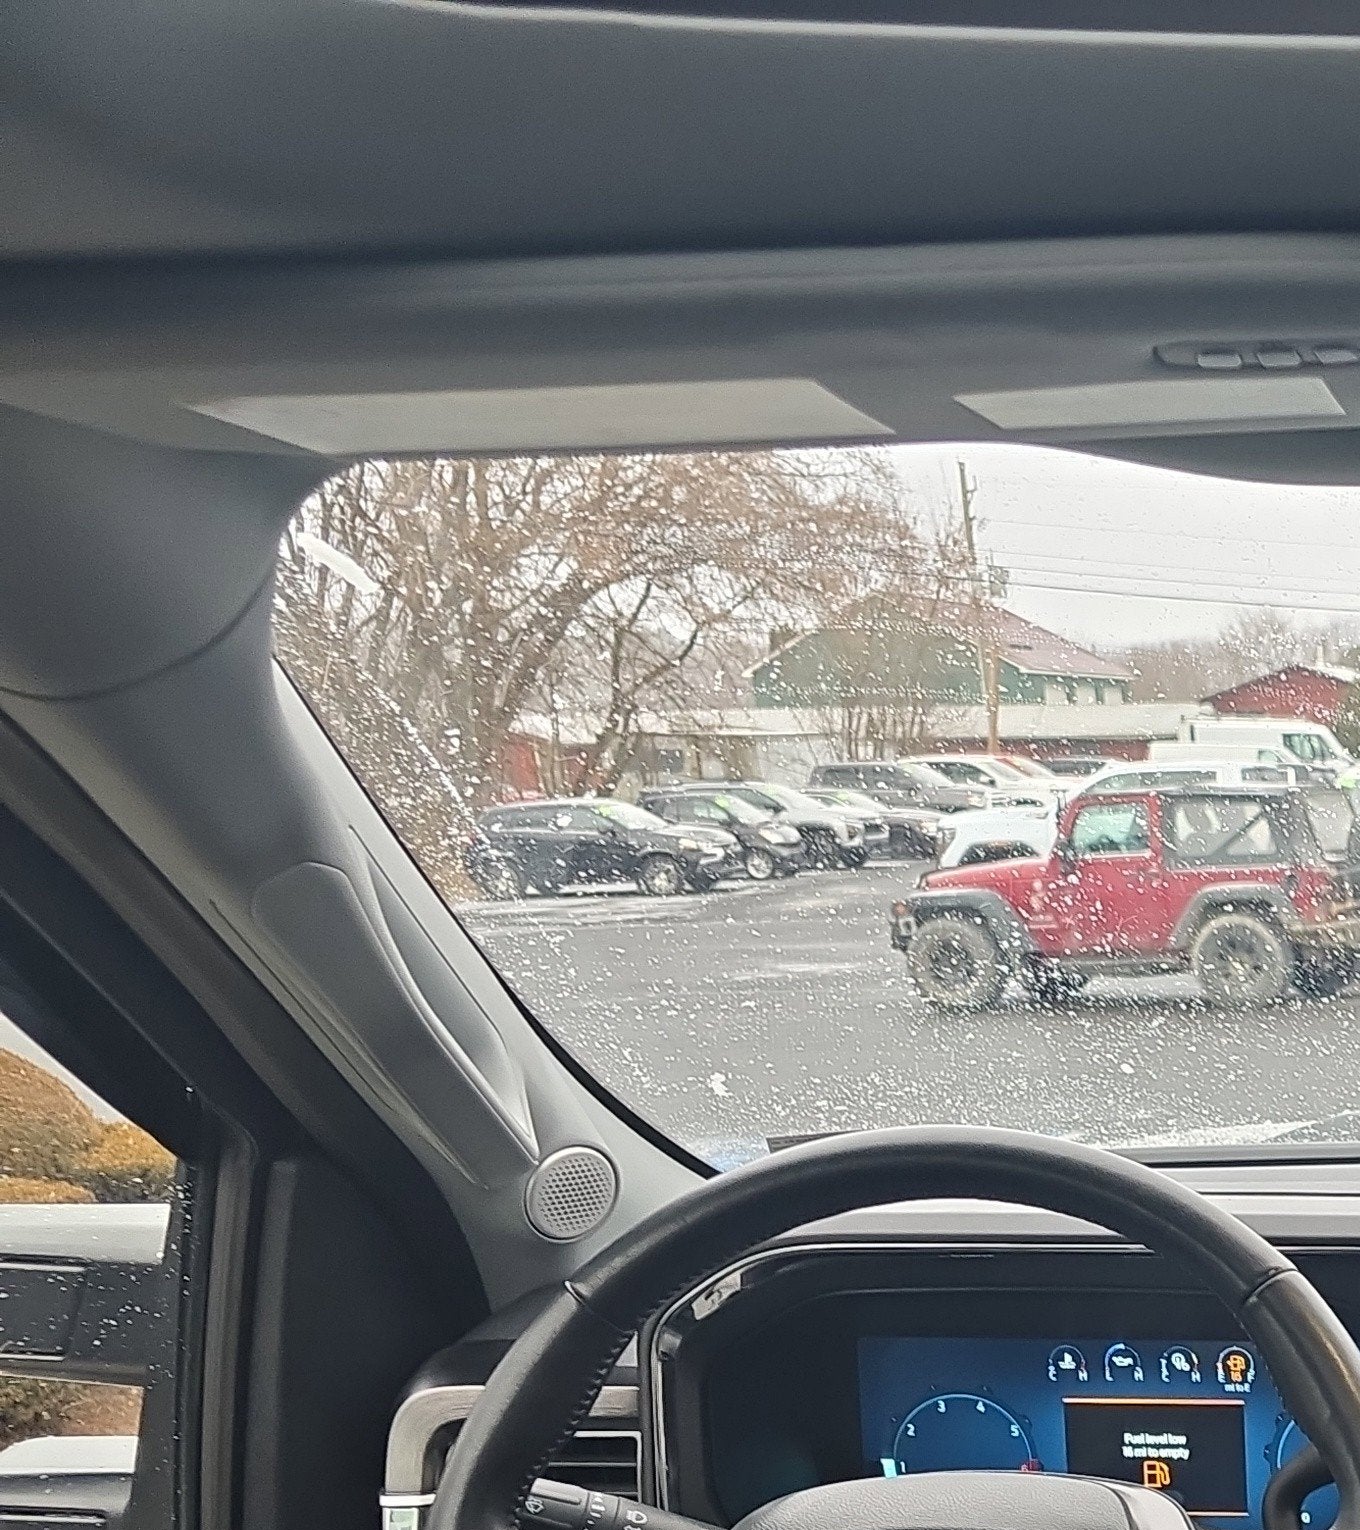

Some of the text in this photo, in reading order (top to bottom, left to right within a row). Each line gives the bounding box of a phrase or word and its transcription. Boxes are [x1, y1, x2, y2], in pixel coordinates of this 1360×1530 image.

[937, 1400, 946, 1413] 3
[976, 1400, 986, 1414] 4
[907, 1423, 916, 1437] 2
[1011, 1424, 1020, 1437] 5
[1124, 1433, 1187, 1445] Fuel level low
[1136, 1446, 1147, 1457] mi
[1159, 1448, 1190, 1460] empty
